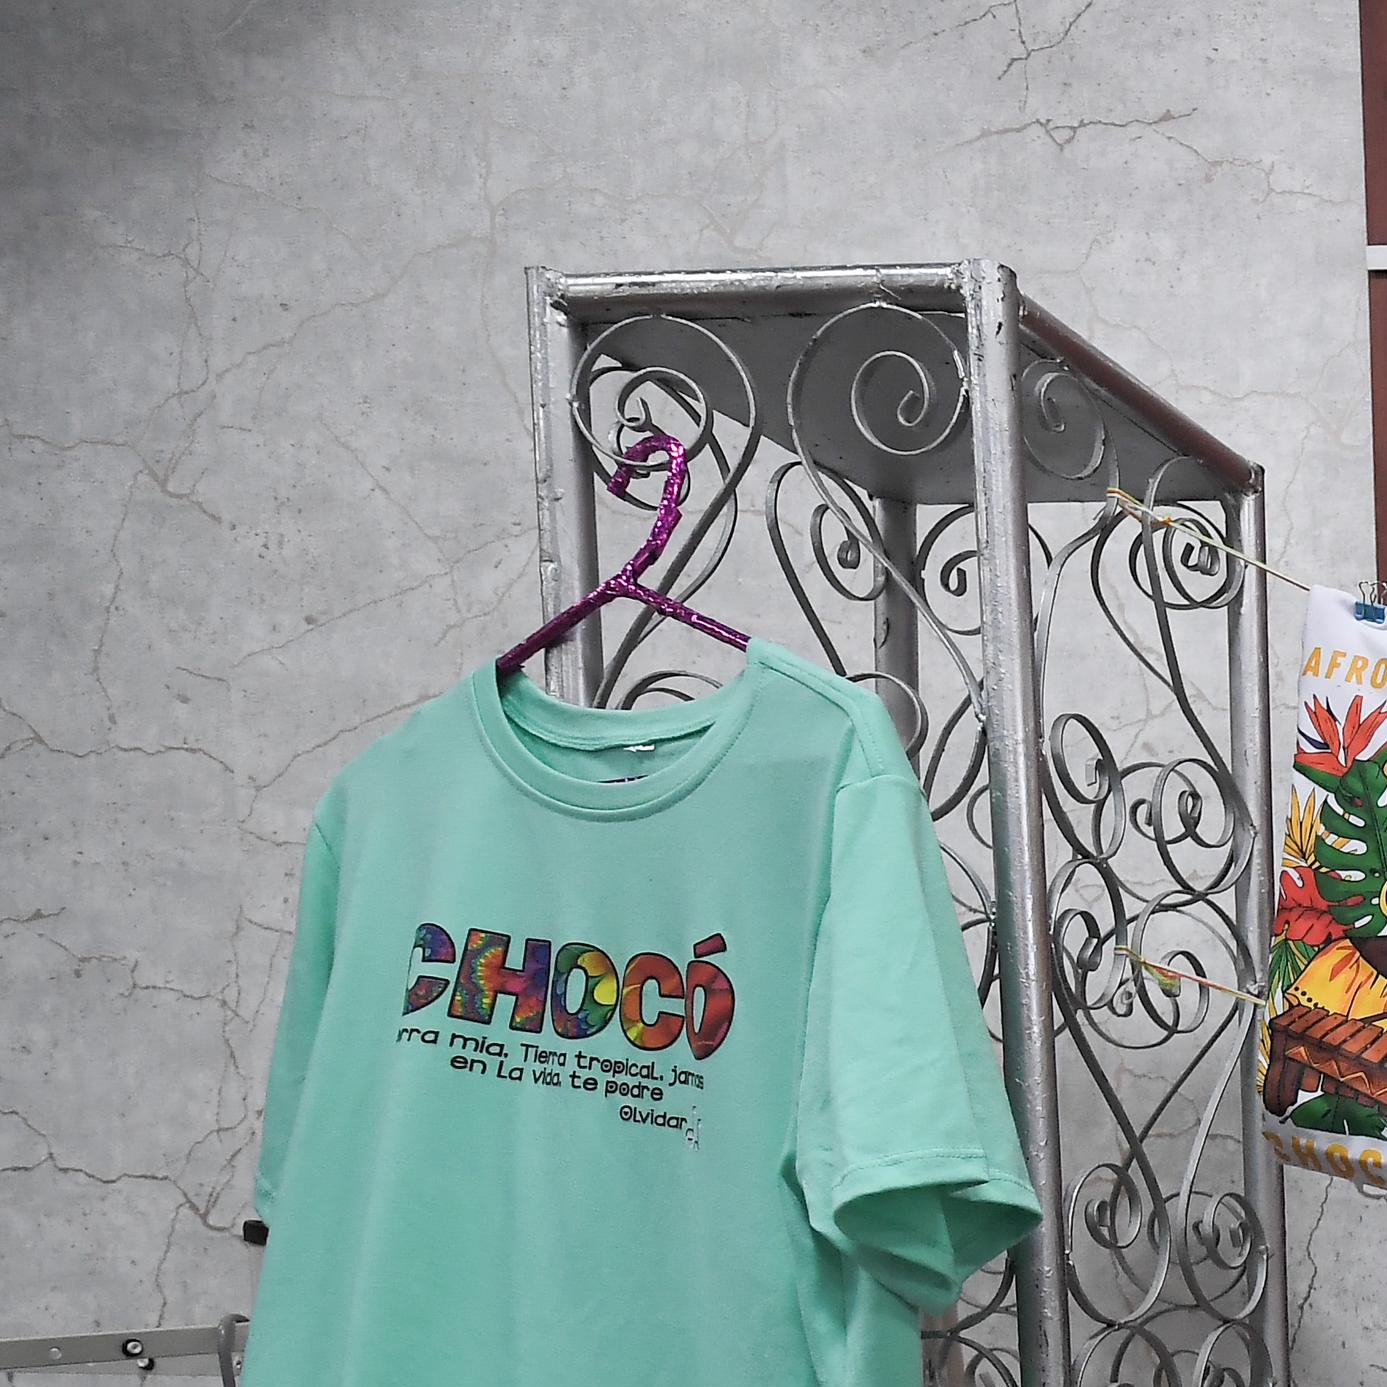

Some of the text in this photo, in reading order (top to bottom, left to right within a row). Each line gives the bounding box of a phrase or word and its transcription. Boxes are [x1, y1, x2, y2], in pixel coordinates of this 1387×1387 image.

[520, 1043, 568, 1067] Tierra
[449, 1055, 488, 1075] en
[569, 1070, 599, 1091] te
[604, 1079, 664, 1102] podre
